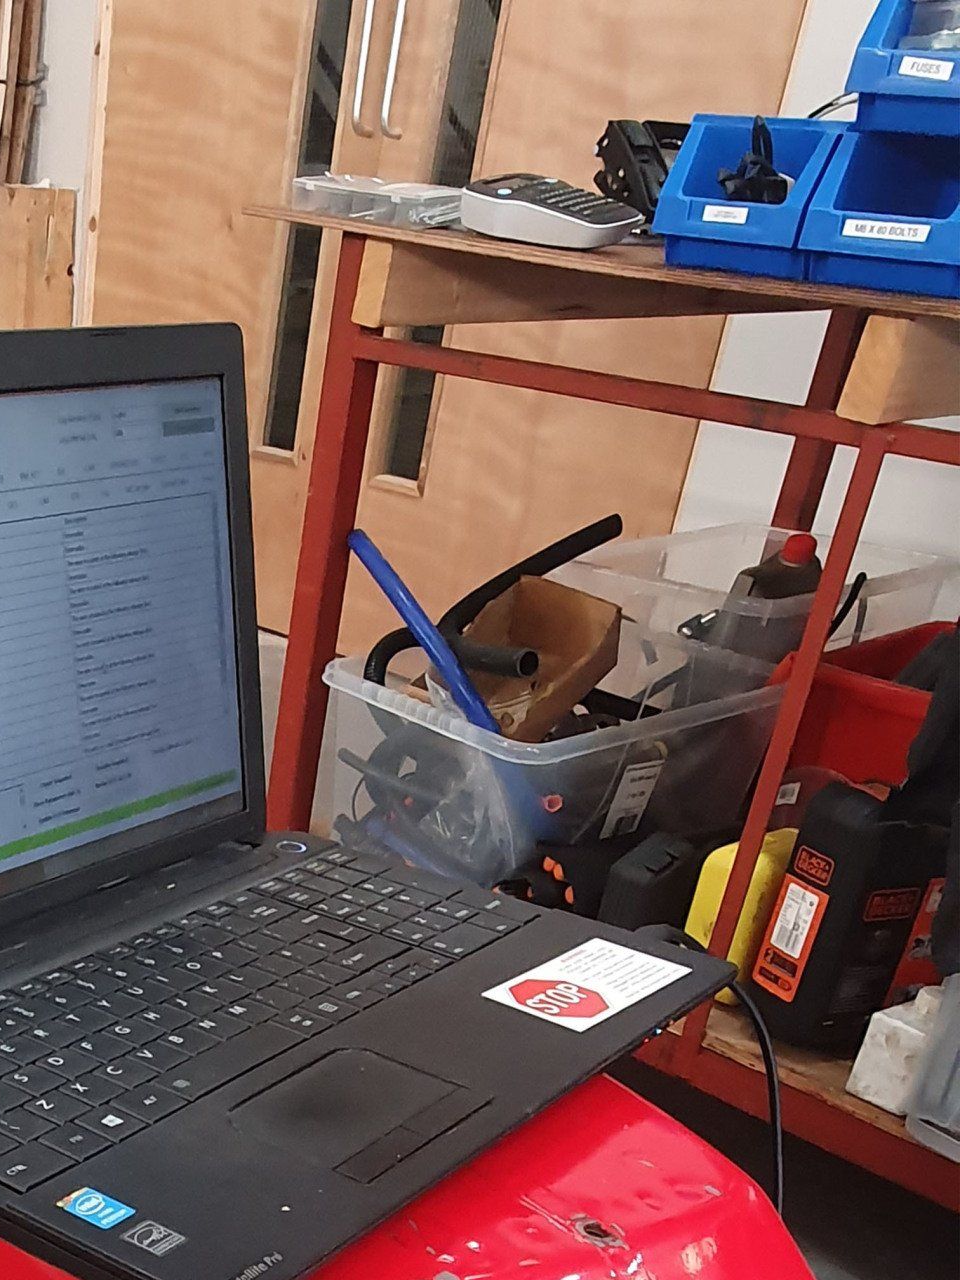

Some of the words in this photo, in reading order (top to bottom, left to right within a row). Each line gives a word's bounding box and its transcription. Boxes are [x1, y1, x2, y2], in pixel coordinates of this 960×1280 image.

[910, 61, 941, 75] FUSES
[889, 226, 919, 238] BOLTS
[525, 982, 588, 1014] STOP
[0, 1044, 16, 1053] E
[13, 1073, 29, 1083] S
[47, 1056, 64, 1066] D
[114, 1025, 132, 1035] G
[143, 1011, 161, 1021] H
[35, 1100, 55, 1110] Z
[70, 1083, 89, 1093] X
[106, 1066, 123, 1075] C
[136, 1050, 154, 1059] V
[263, 1251, 284, 1268] Pro
